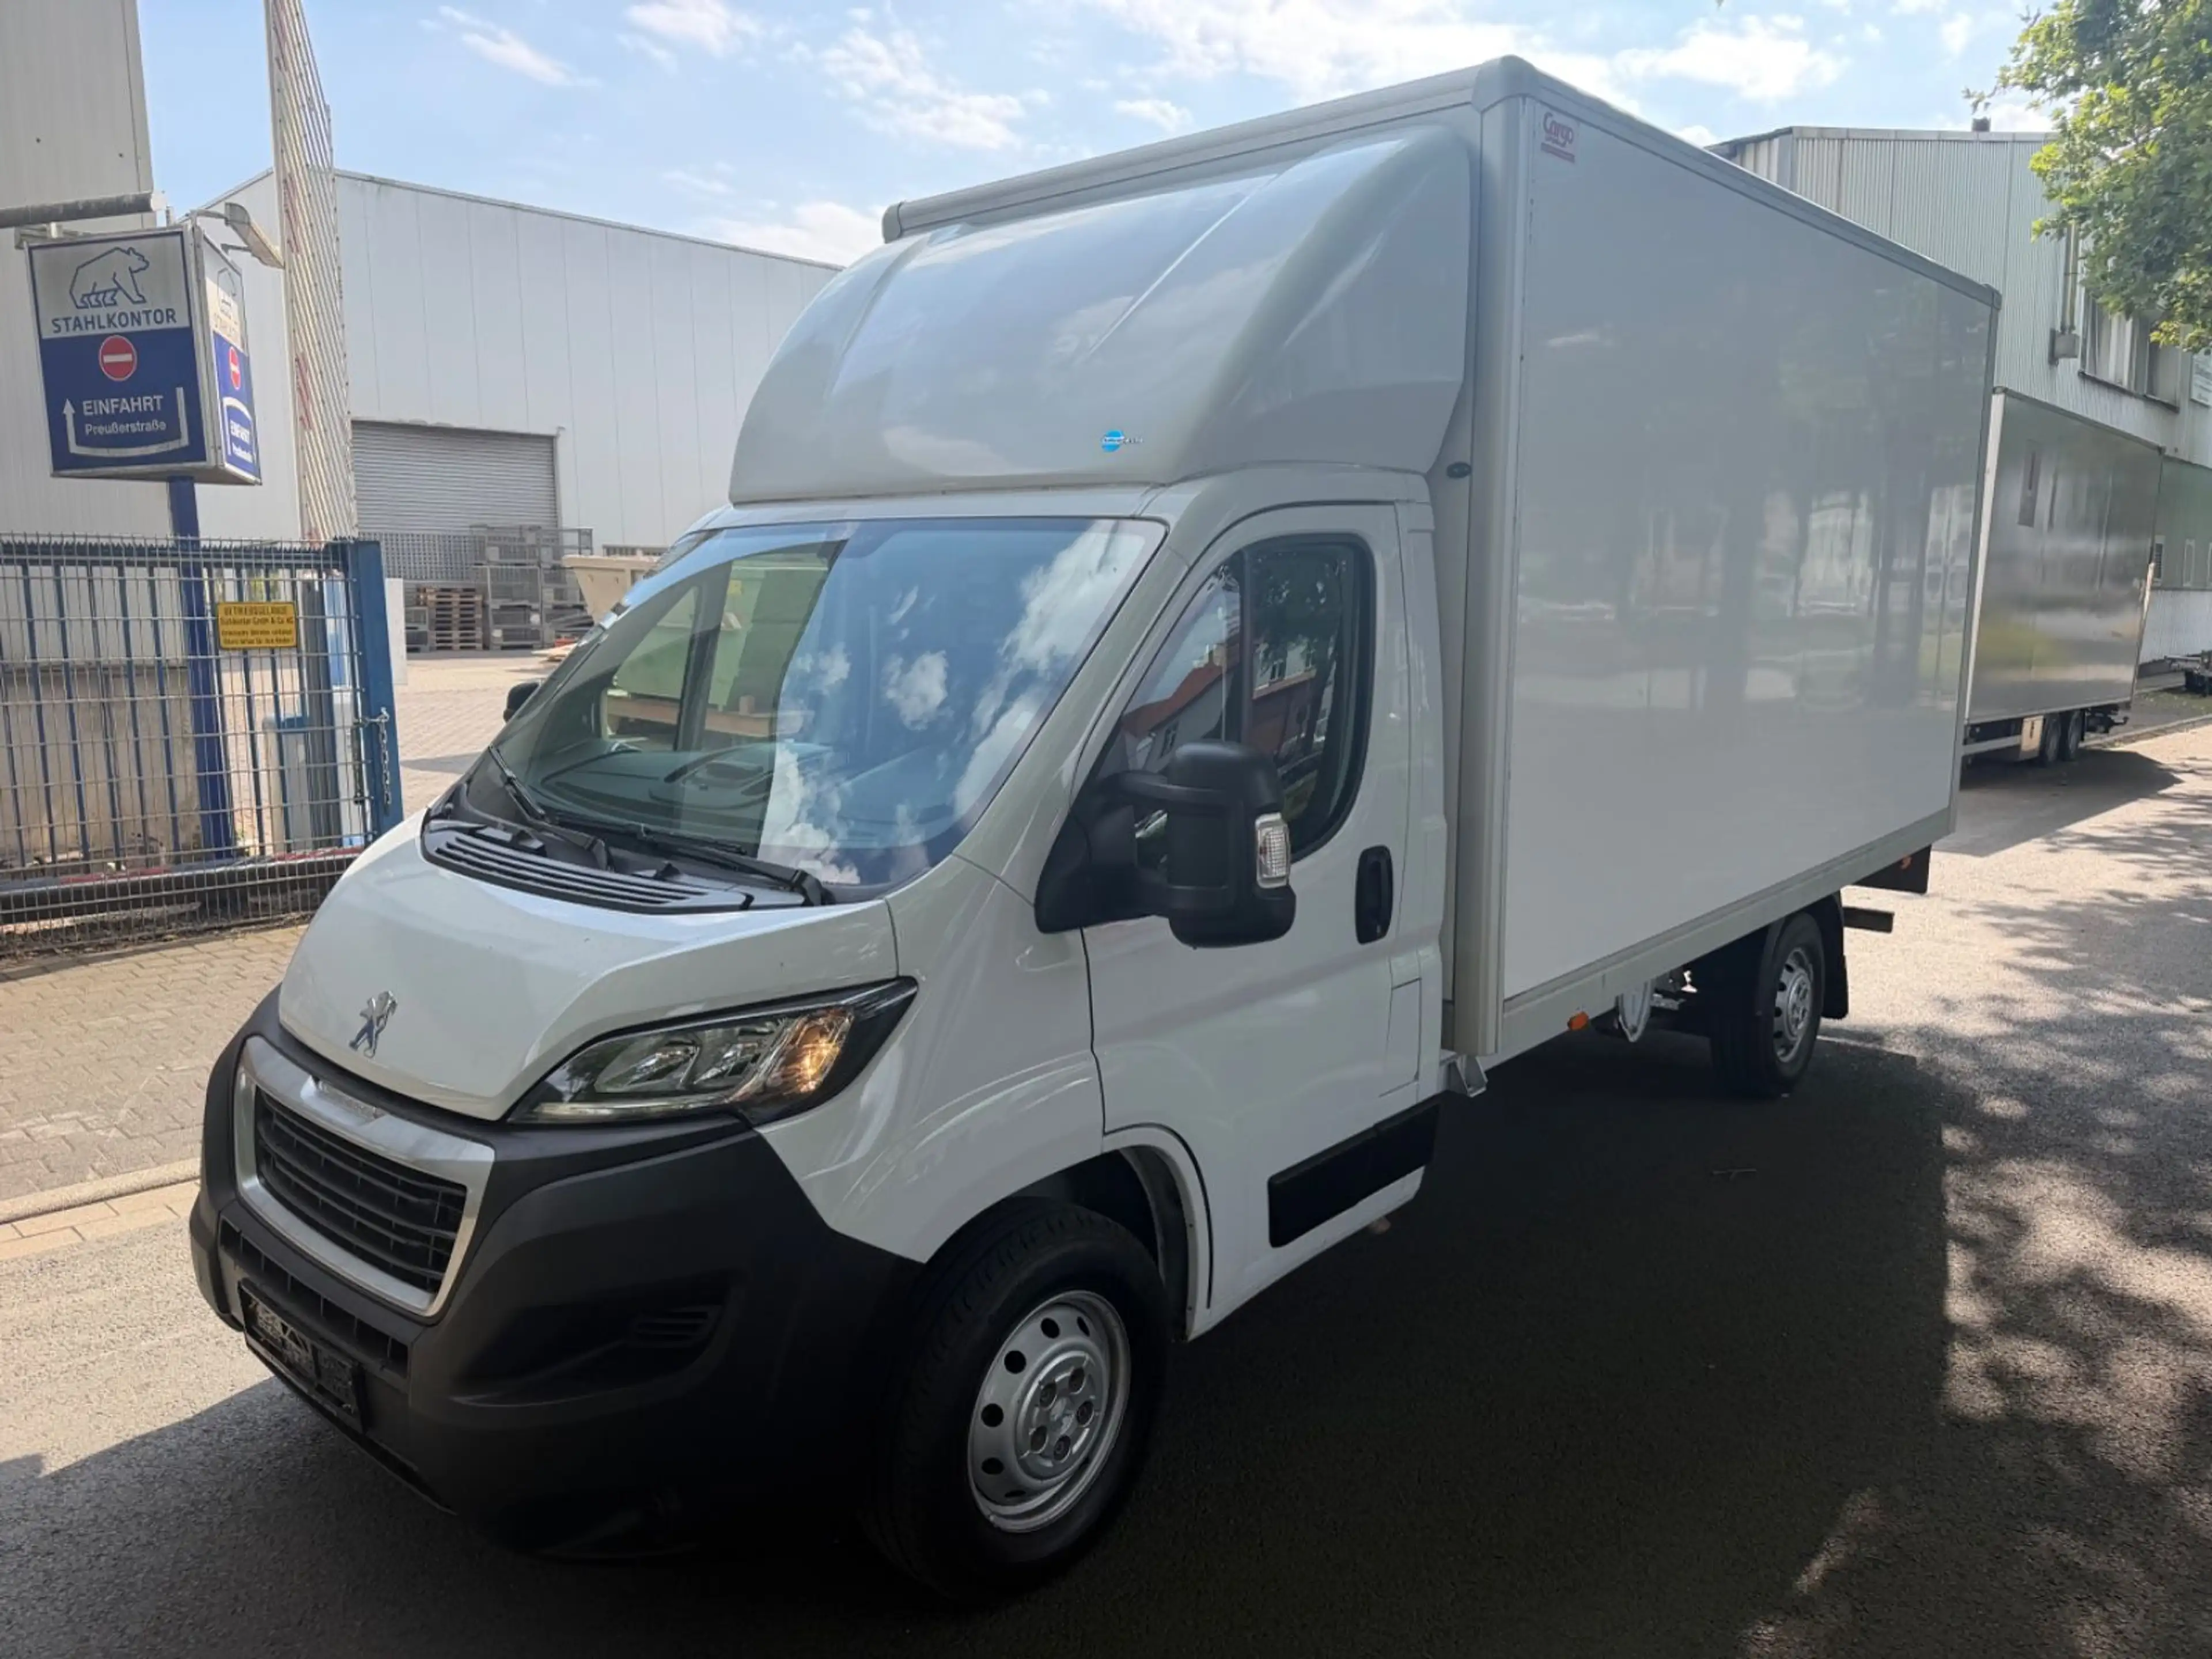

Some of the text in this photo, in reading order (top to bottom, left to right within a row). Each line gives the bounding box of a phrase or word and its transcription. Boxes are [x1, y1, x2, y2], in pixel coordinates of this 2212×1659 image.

[1543, 112, 1574, 147] Cargo
[51, 308, 177, 334] STAHLKONTOR
[82, 395, 164, 416] EINFAHRT
